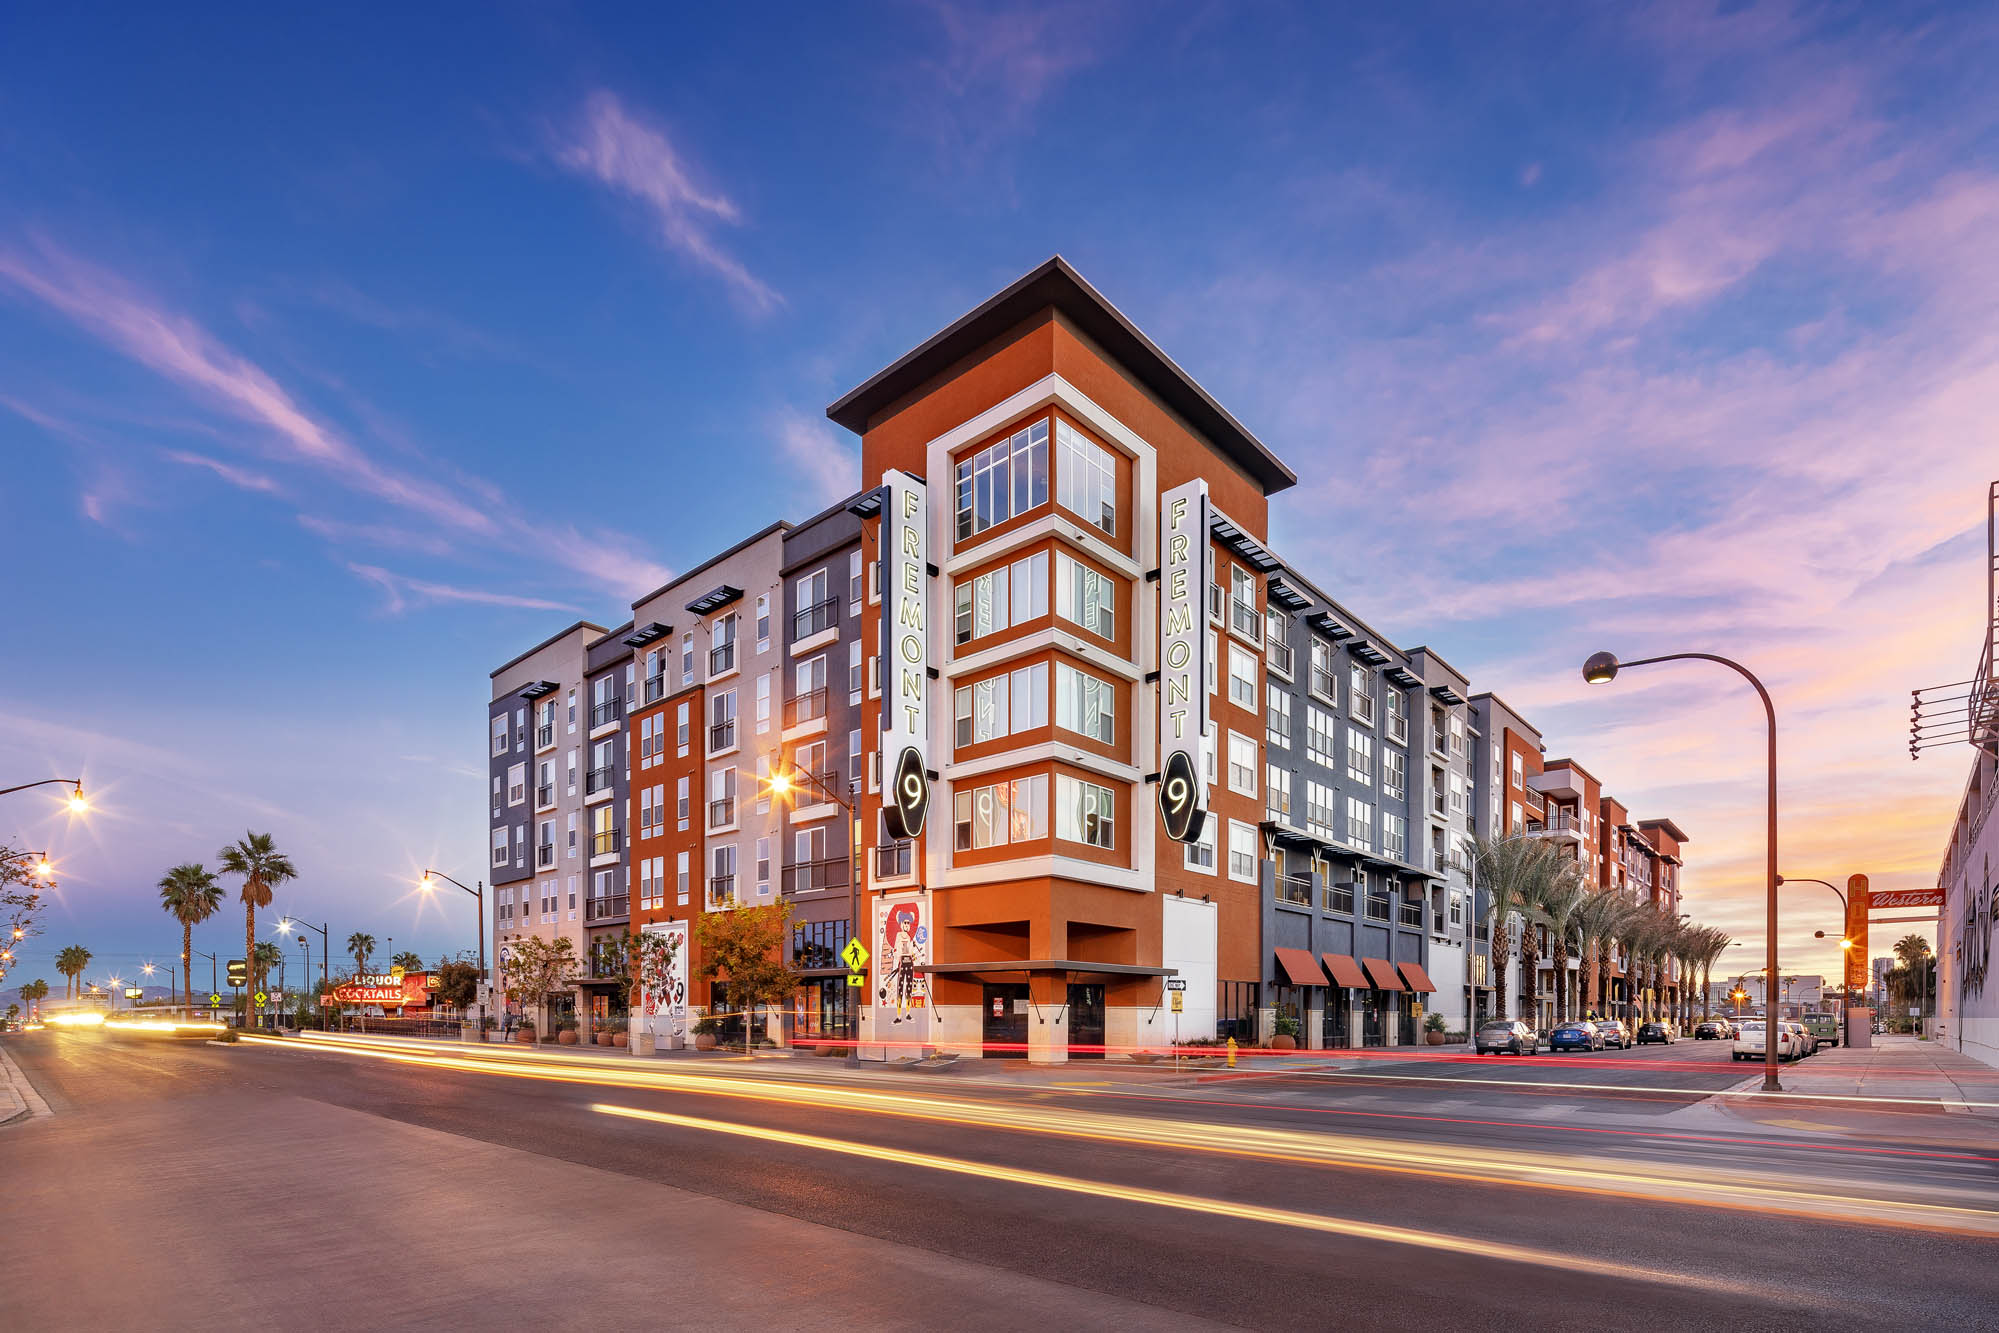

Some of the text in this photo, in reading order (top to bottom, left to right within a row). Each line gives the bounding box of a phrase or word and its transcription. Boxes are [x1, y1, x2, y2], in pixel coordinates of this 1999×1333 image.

[900, 489, 923, 735] FREMONT
[1166, 497, 1192, 739] FREMONT
[903, 773, 922, 811] 9
[1167, 777, 1189, 815] 9
[1872, 891, 1943, 907] Western
[339, 988, 402, 1000] COCKTAILS
[354, 975, 401, 986] LIQUOR
[676, 982, 684, 1005] 9
